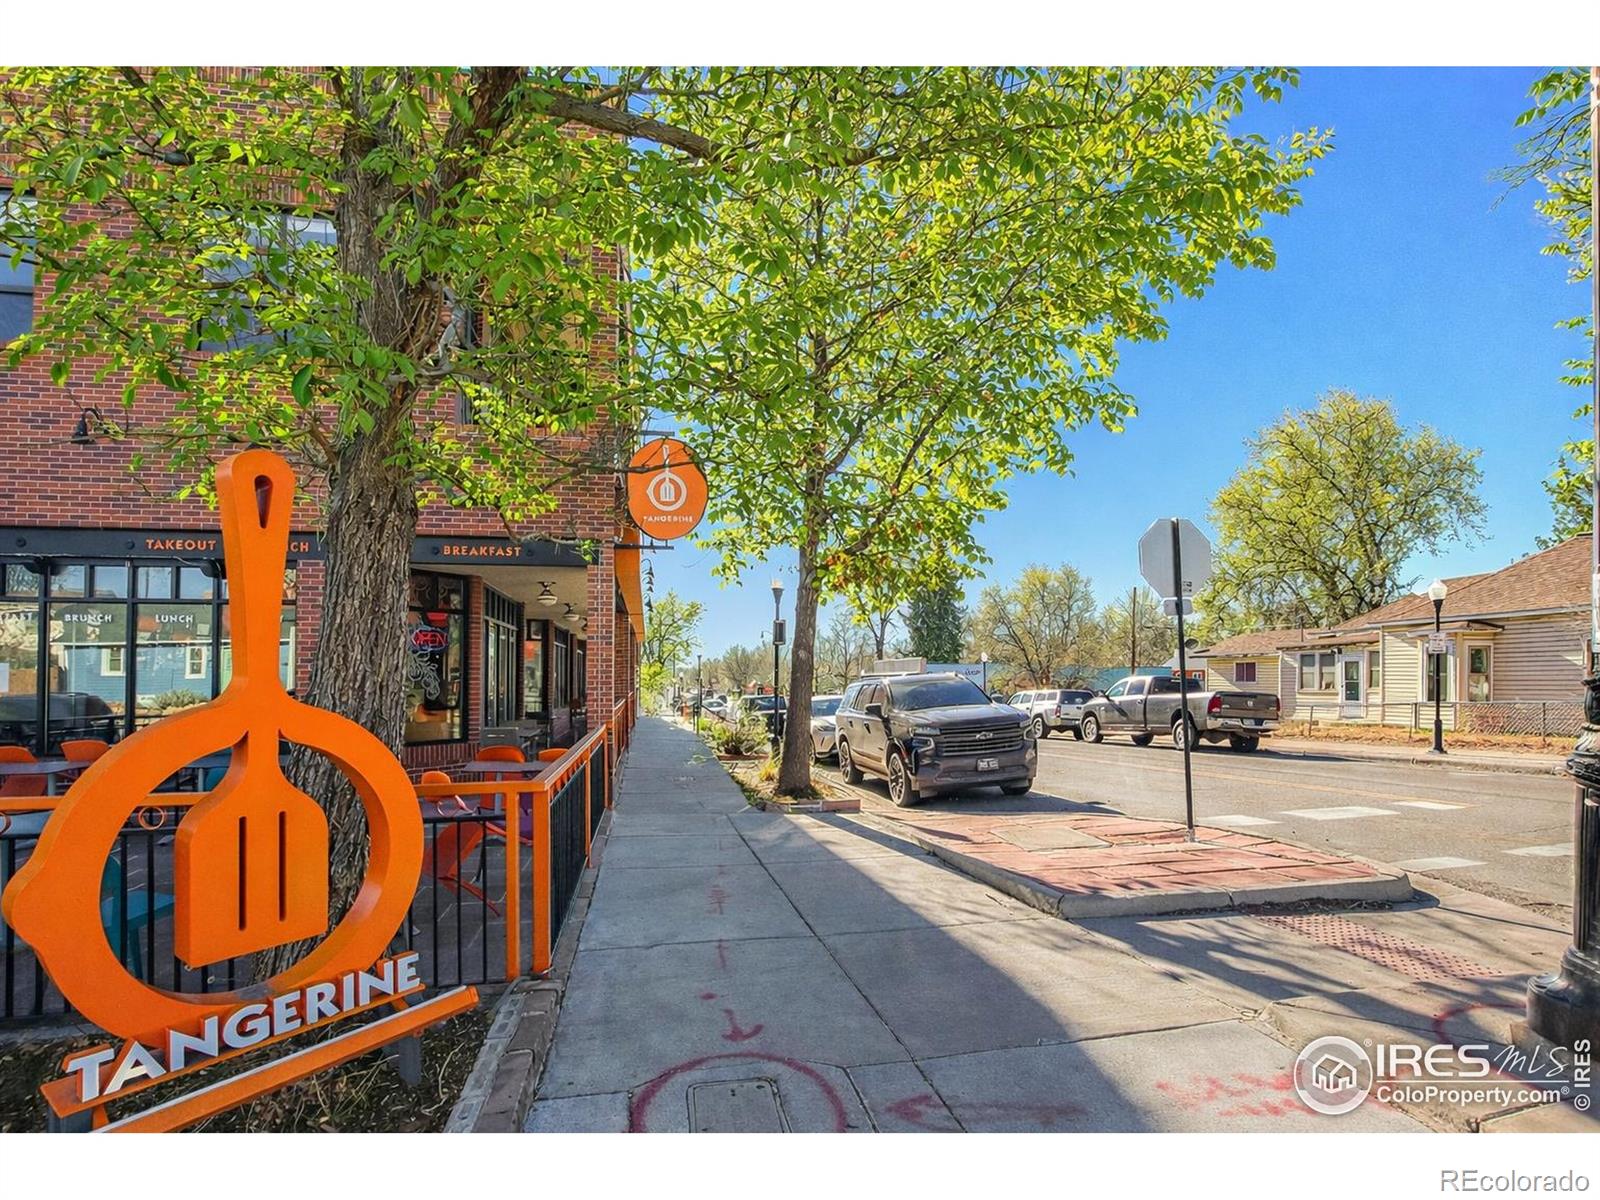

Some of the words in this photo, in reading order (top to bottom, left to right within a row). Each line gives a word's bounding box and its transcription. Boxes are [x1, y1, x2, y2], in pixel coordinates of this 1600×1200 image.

[145, 539, 217, 551] TAKEOUT
[443, 545, 522, 557] BREAKFAST
[64, 614, 112, 623] BRUNCH
[155, 614, 193, 624] LUNCH
[64, 951, 422, 1103] TANGERINE
